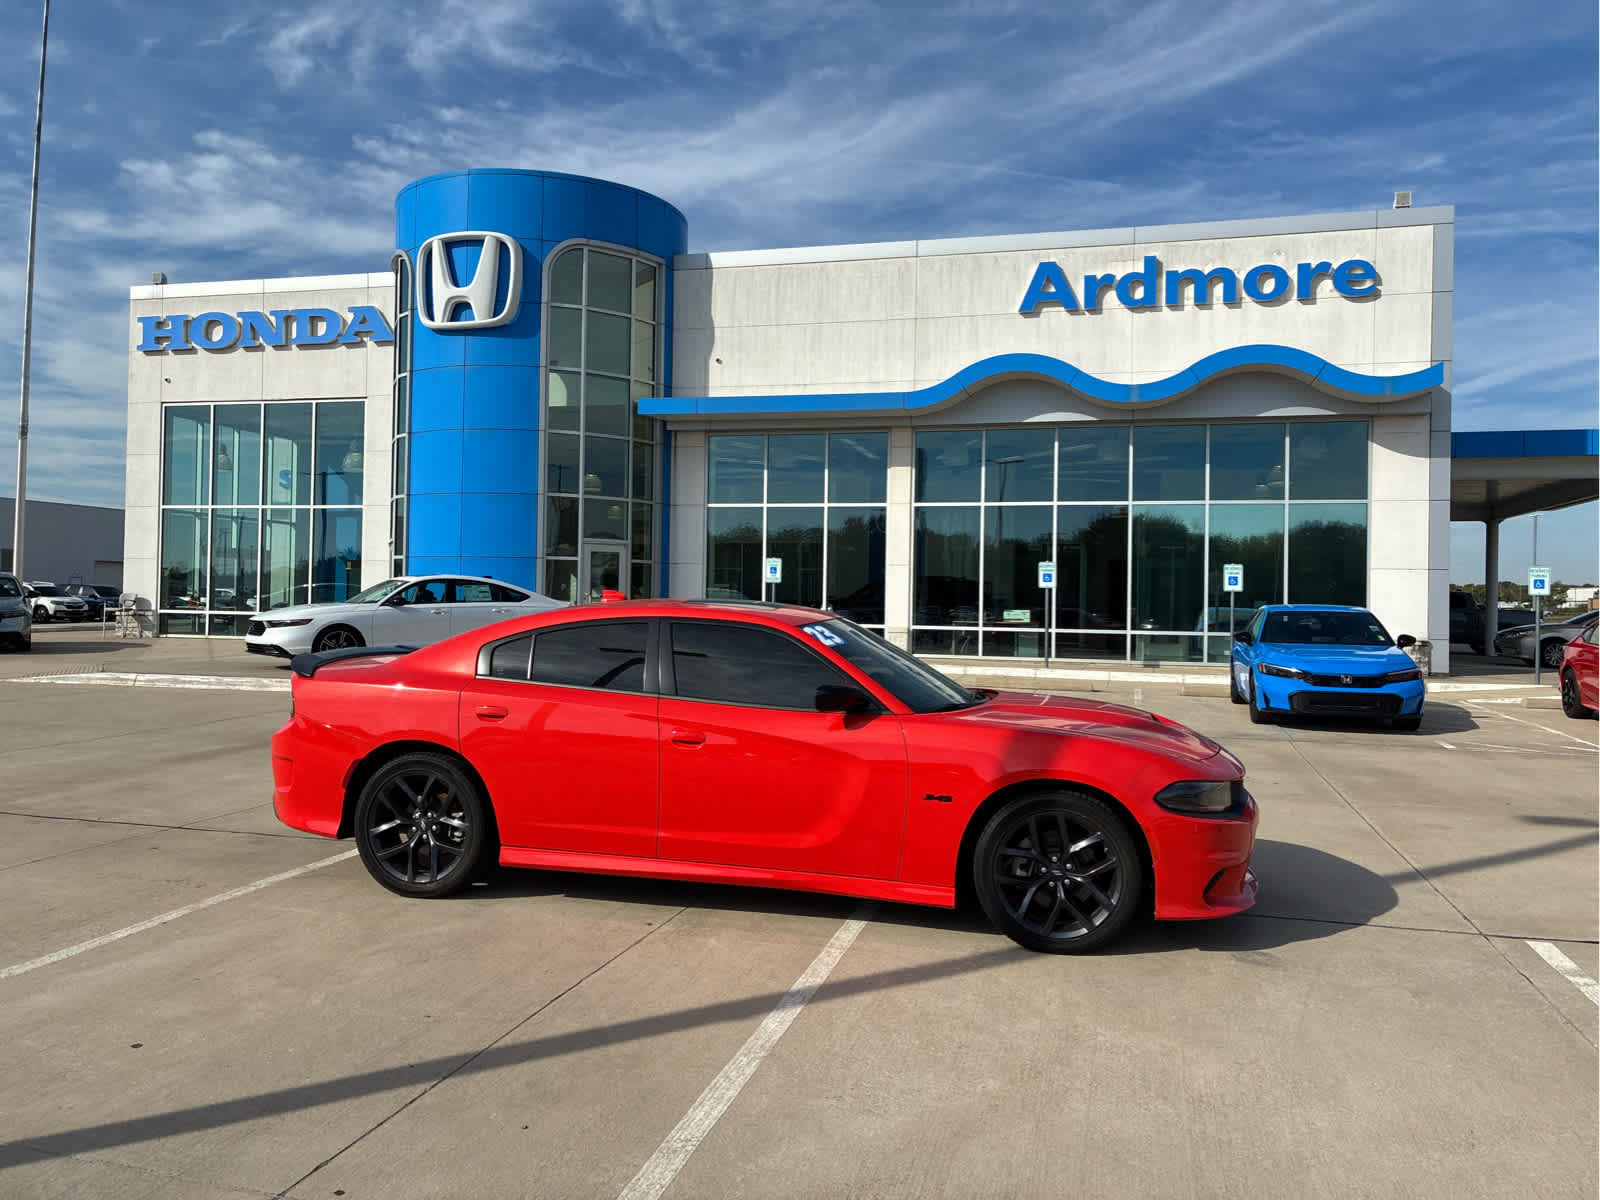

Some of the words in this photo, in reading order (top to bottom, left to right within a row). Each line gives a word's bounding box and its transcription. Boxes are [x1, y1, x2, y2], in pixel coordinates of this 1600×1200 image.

[1018, 255, 1379, 313] Ardmore
[136, 305, 394, 351] HONDA
[802, 625, 845, 647] 23
